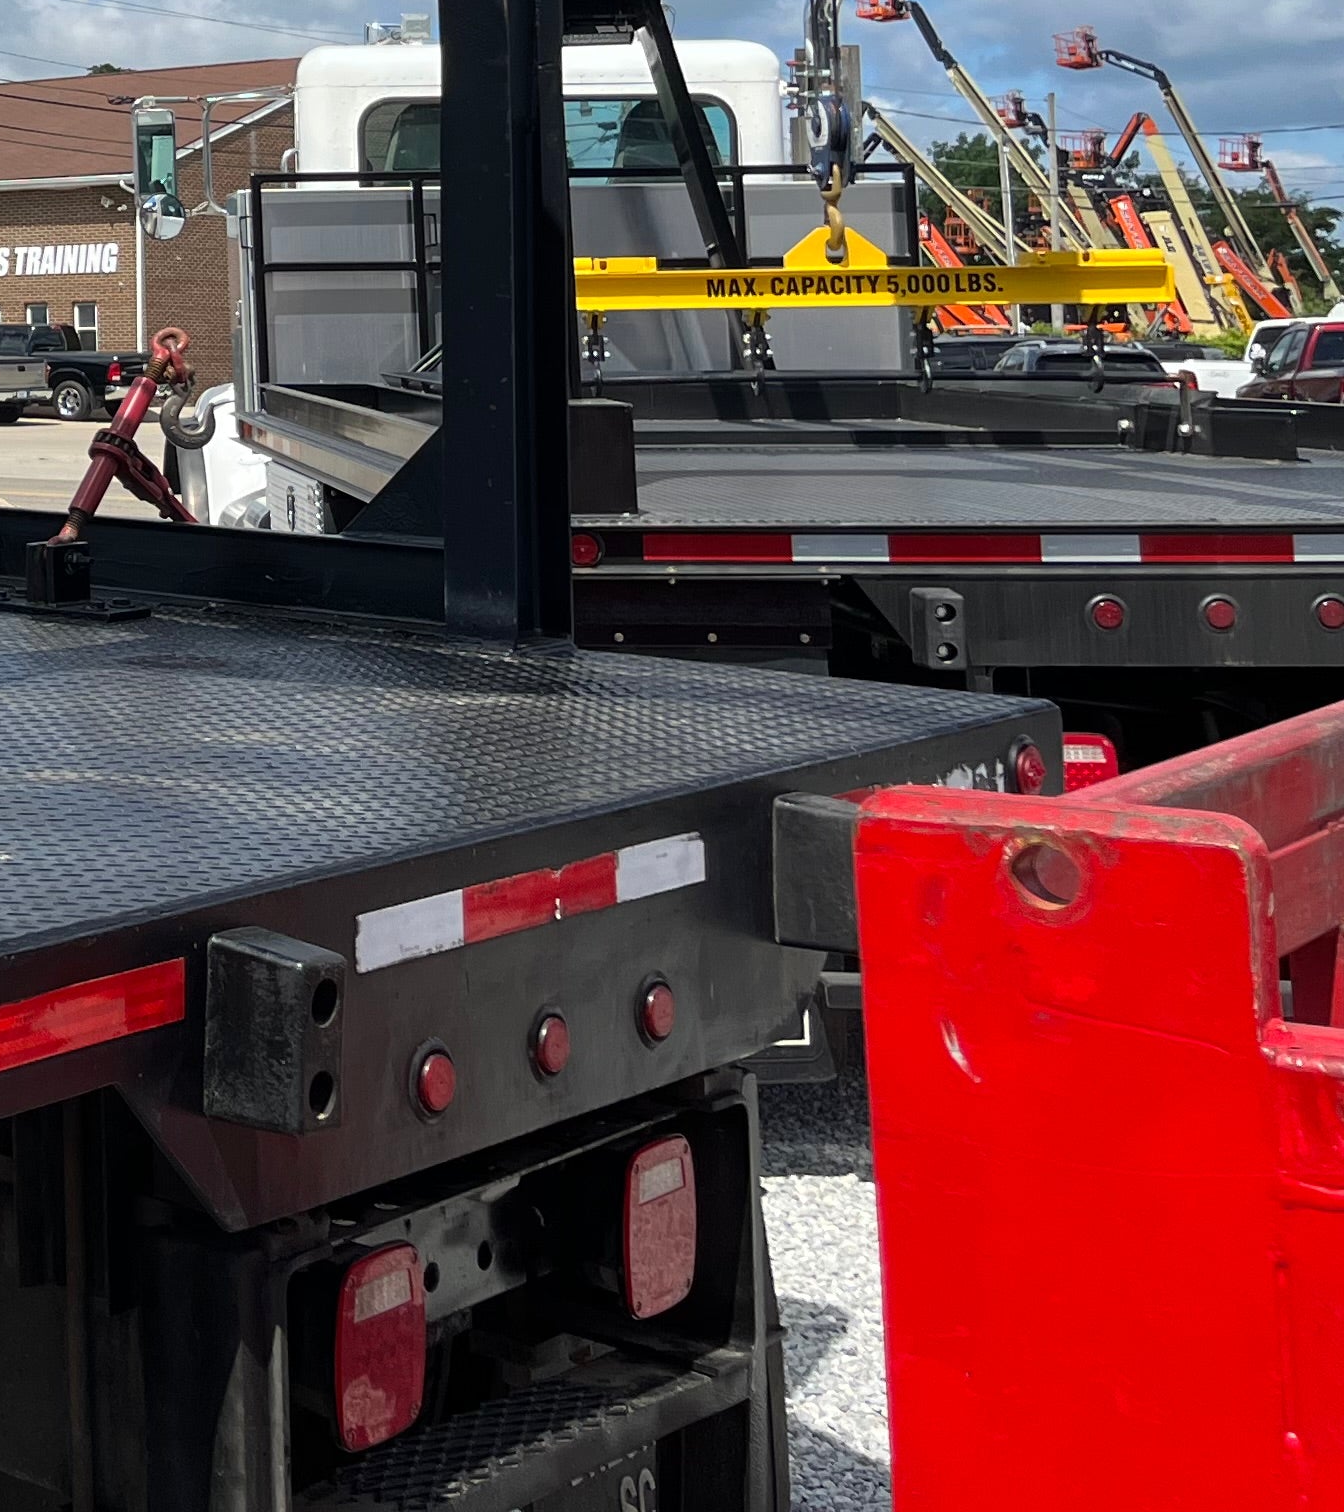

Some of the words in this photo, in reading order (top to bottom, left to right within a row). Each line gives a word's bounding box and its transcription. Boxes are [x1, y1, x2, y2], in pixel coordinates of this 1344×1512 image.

[14, 243, 119, 276] TRAINING
[706, 277, 764, 298] MAX.
[770, 275, 880, 296] CAPACITY
[887, 274, 950, 298] 5,000
[955, 272, 1004, 293] LBS.
